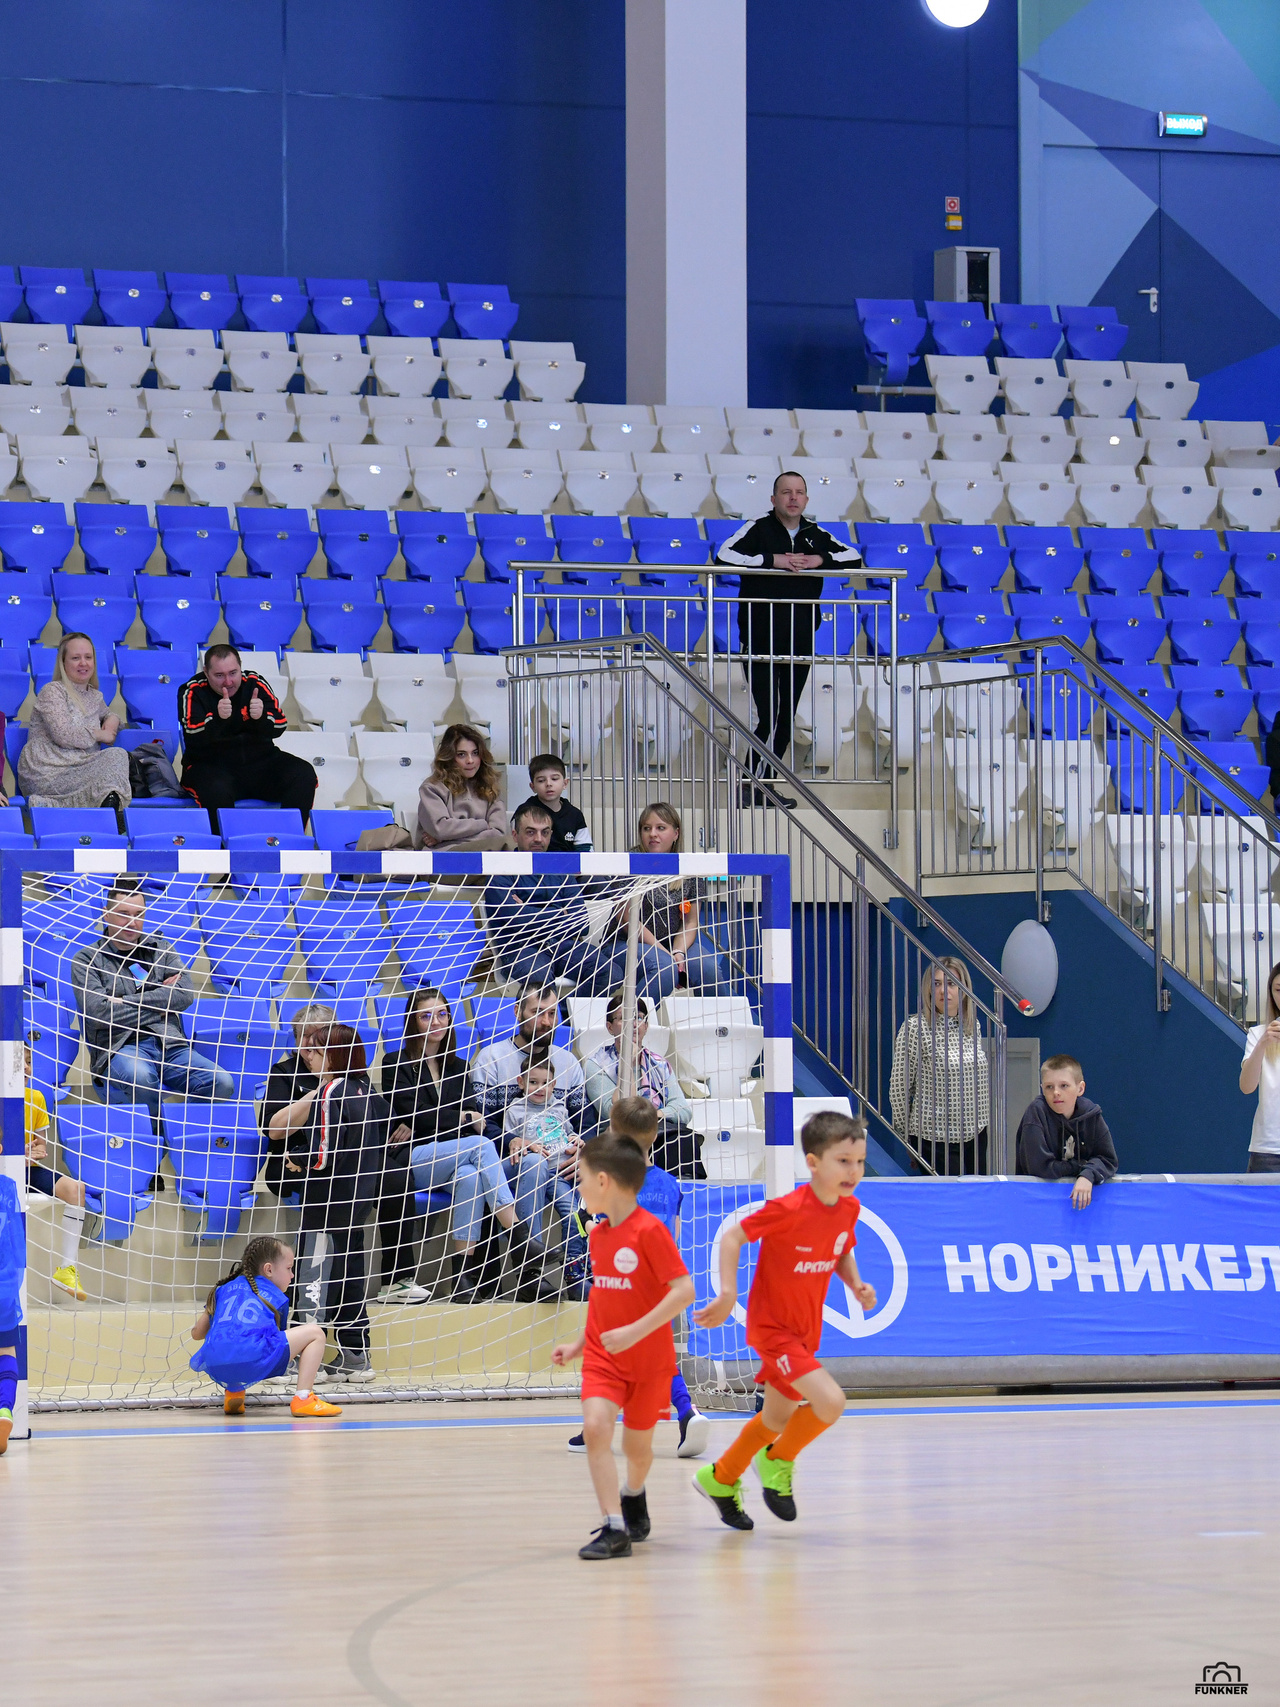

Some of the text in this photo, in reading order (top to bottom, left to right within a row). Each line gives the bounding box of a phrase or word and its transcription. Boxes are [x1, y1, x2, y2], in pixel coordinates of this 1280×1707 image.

[1166, 117, 1203, 131] ВЫХОД
[942, 1243, 1280, 1293] НОРНИКЕЛ
[218, 1294, 264, 1324] 16
[776, 1354, 792, 1376] 17
